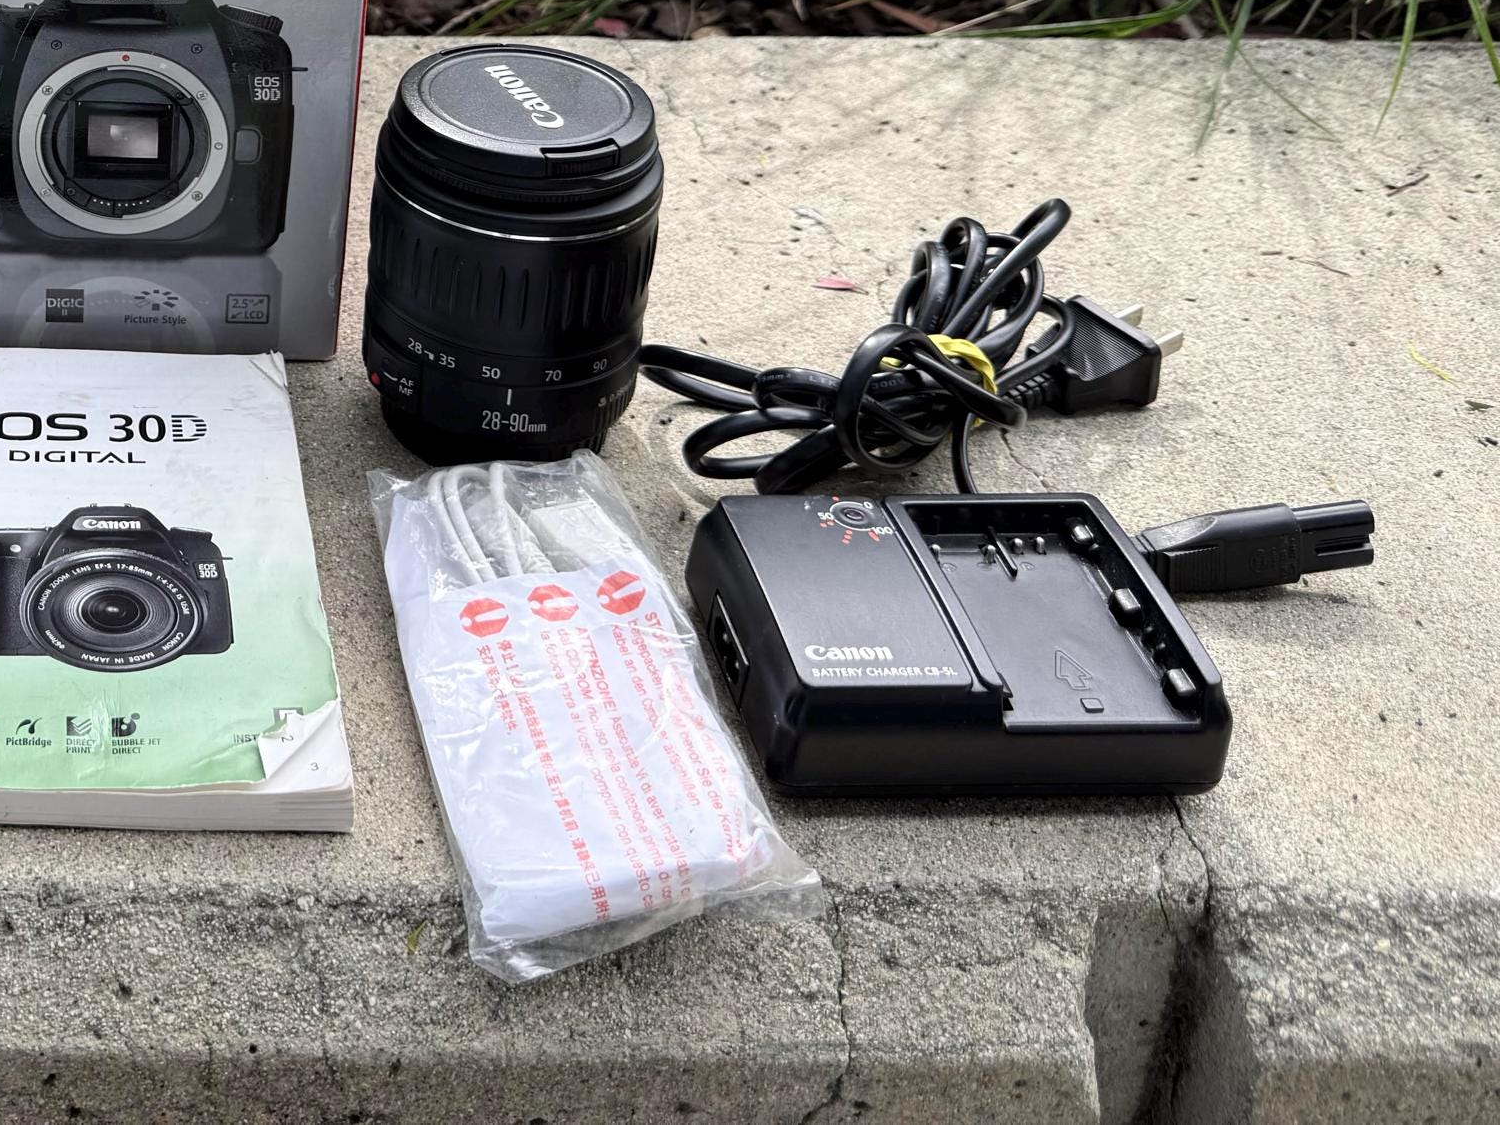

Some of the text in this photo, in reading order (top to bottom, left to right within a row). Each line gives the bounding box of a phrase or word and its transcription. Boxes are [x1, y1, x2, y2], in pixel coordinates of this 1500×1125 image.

[254, 76, 280, 87] EOS
[253, 88, 281, 101] 30D
[484, 64, 564, 129] Canon
[124, 314, 187, 325] Picture Style
[244, 310, 264, 320] LCD
[407, 337, 608, 382] 28 35 50 70 90
[400, 378, 415, 387] AF
[399, 385, 413, 397] MF
[481, 410, 547, 433] 28-90mm
[109, 414, 208, 443] 30D
[8, 449, 146, 465] DIGITAL
[863, 501, 873, 510] 0
[817, 511, 835, 521] 50
[82, 519, 141, 530] Canon
[872, 526, 894, 535] 100
[198, 563, 216, 571] EOS
[199, 570, 218, 578] 30D
[38, 588, 52, 611] CANON
[50, 572, 70, 589] ZOOM
[72, 565, 91, 576] LENS
[116, 564, 153, 577] 17-85mm
[162, 632, 184, 651] CANON
[81, 653, 110, 664] JAPAN
[128, 652, 155, 663] MADE
[804, 645, 894, 661] Canon
[811, 667, 862, 677] BATTERY
[865, 667, 921, 676] CHARGER
[630, 674, 648, 697] den
[5, 738, 52, 748] PictBridge
[66, 739, 97, 747] DIRECT
[111, 738, 161, 746] BUBBLE JET
[111, 746, 142, 755] DIRECT
[310, 762, 319, 771] 3
[633, 767, 648, 781] Vi
[639, 781, 653, 794] di
[695, 765, 714, 788] Sie
[706, 788, 725, 811] die
[645, 793, 665, 821] aver
[641, 833, 664, 868] prima
[614, 821, 632, 846] con
[623, 844, 653, 892] questo
